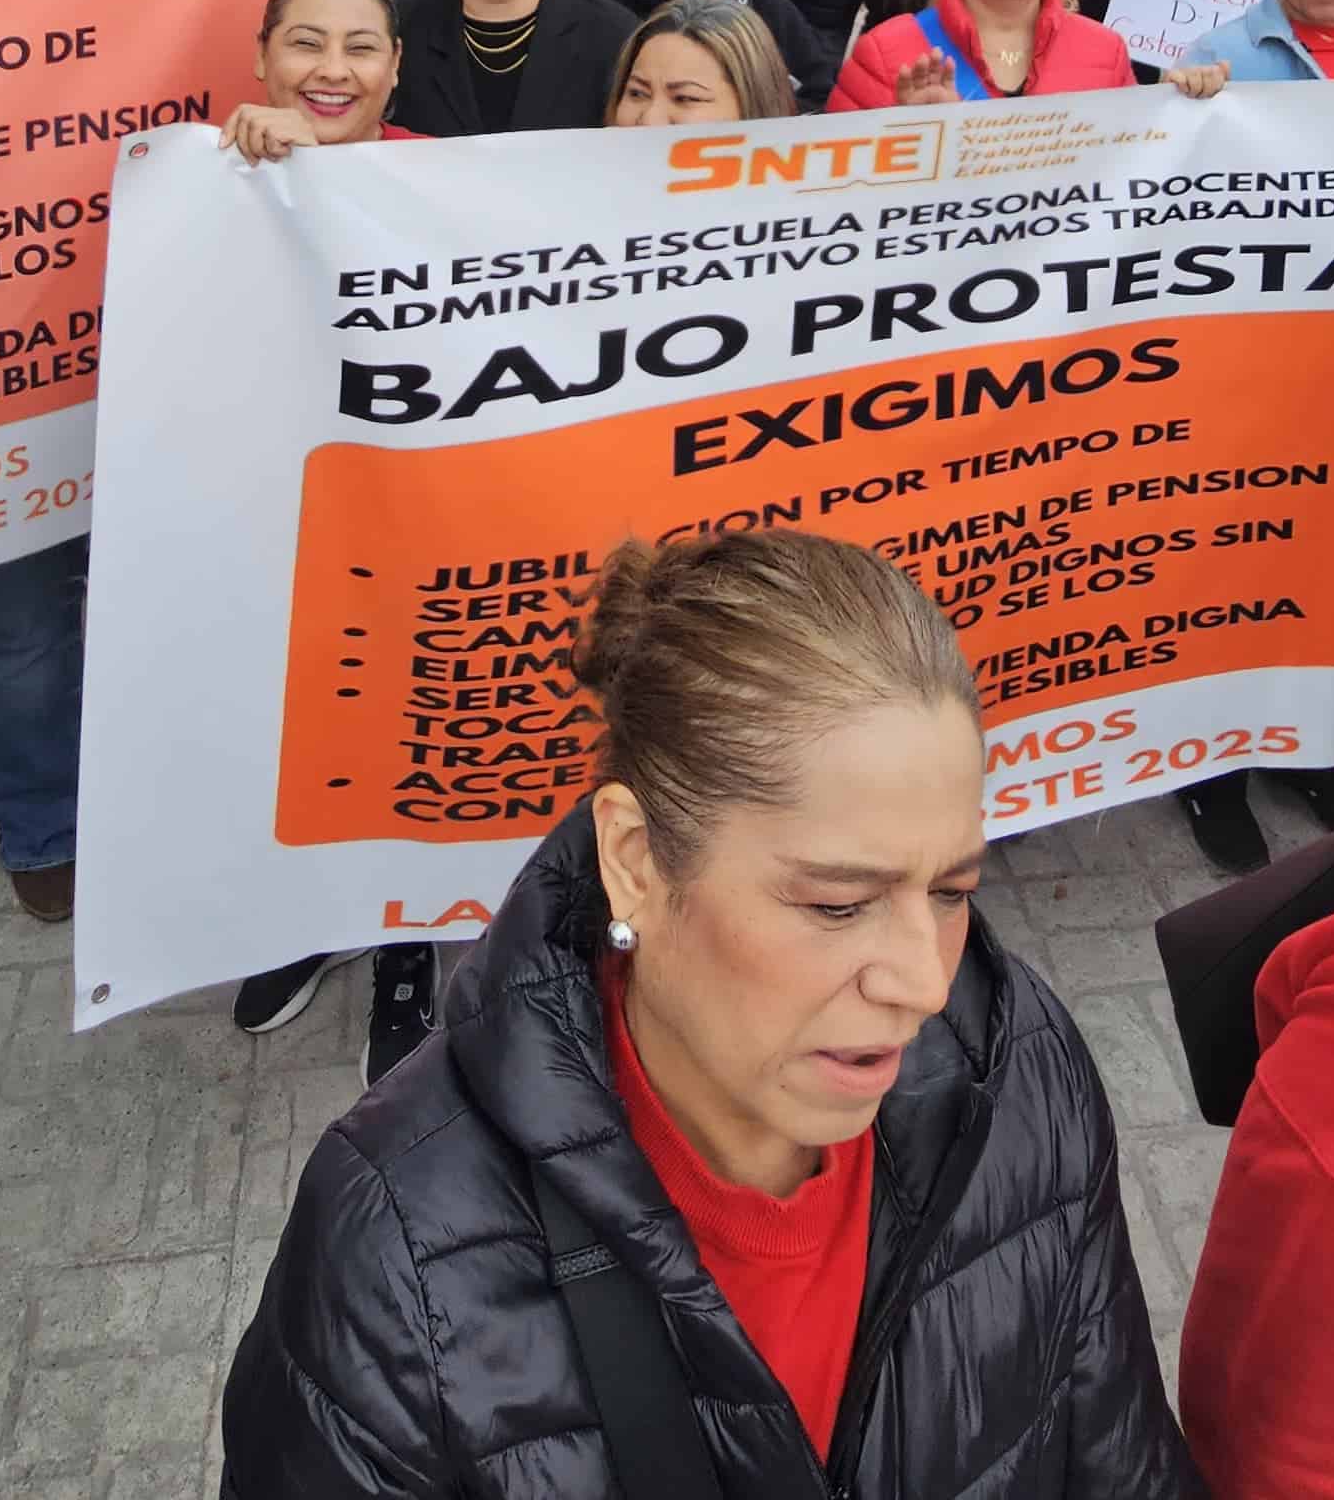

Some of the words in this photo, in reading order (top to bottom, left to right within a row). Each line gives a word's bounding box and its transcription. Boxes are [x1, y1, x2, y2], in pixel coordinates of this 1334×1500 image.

[45, 26, 97, 64] DE
[25, 91, 211, 151] PENSION
[957, 135, 1105, 162] Trabajadores
[1112, 131, 1138, 144] de
[1144, 129, 1170, 141] la
[959, 110, 1070, 131] Sindicato
[959, 124, 1061, 146] Nacional
[1070, 121, 1095, 134] de
[331, 242, 860, 331] ADMINISTRATIVO
[874, 211, 1090, 260] ESTAMOS
[338, 263, 429, 298] EN
[451, 243, 606, 285] ESTA
[624, 211, 863, 262] ESCUELA
[878, 181, 1114, 230] PERSONAL
[338, 314, 749, 425] BAJO
[673, 338, 1180, 477] EXIGIMOS
[820, 467, 927, 515] POR
[943, 429, 1119, 483] TIEMPO
[1132, 419, 1192, 446] DE
[407, 678, 579, 712] SERV
[934, 574, 996, 607] UD
[1009, 530, 1197, 586] DIGNOS
[1211, 519, 1294, 547] SIN
[411, 646, 573, 682] ELIM
[937, 521, 1071, 577] UMAS
[413, 616, 582, 652] CAM
[873, 504, 1025, 560] GIMEN
[1040, 489, 1093, 521] DE
[1107, 463, 1329, 507] PENSION
[417, 586, 593, 623] SERV
[394, 763, 587, 795] ACCE
[1144, 598, 1306, 635] DIGNA
[403, 704, 605, 739] TOCA
[952, 605, 984, 630] O
[997, 583, 1049, 617] SE
[1063, 562, 1155, 601] LOS
[393, 796, 554, 822] CON
[977, 641, 1178, 709] CESIBLES
[986, 709, 1137, 773] MOS
[383, 899, 494, 929] LA
[983, 765, 1103, 821] STE
[1125, 725, 1300, 785] 2025
